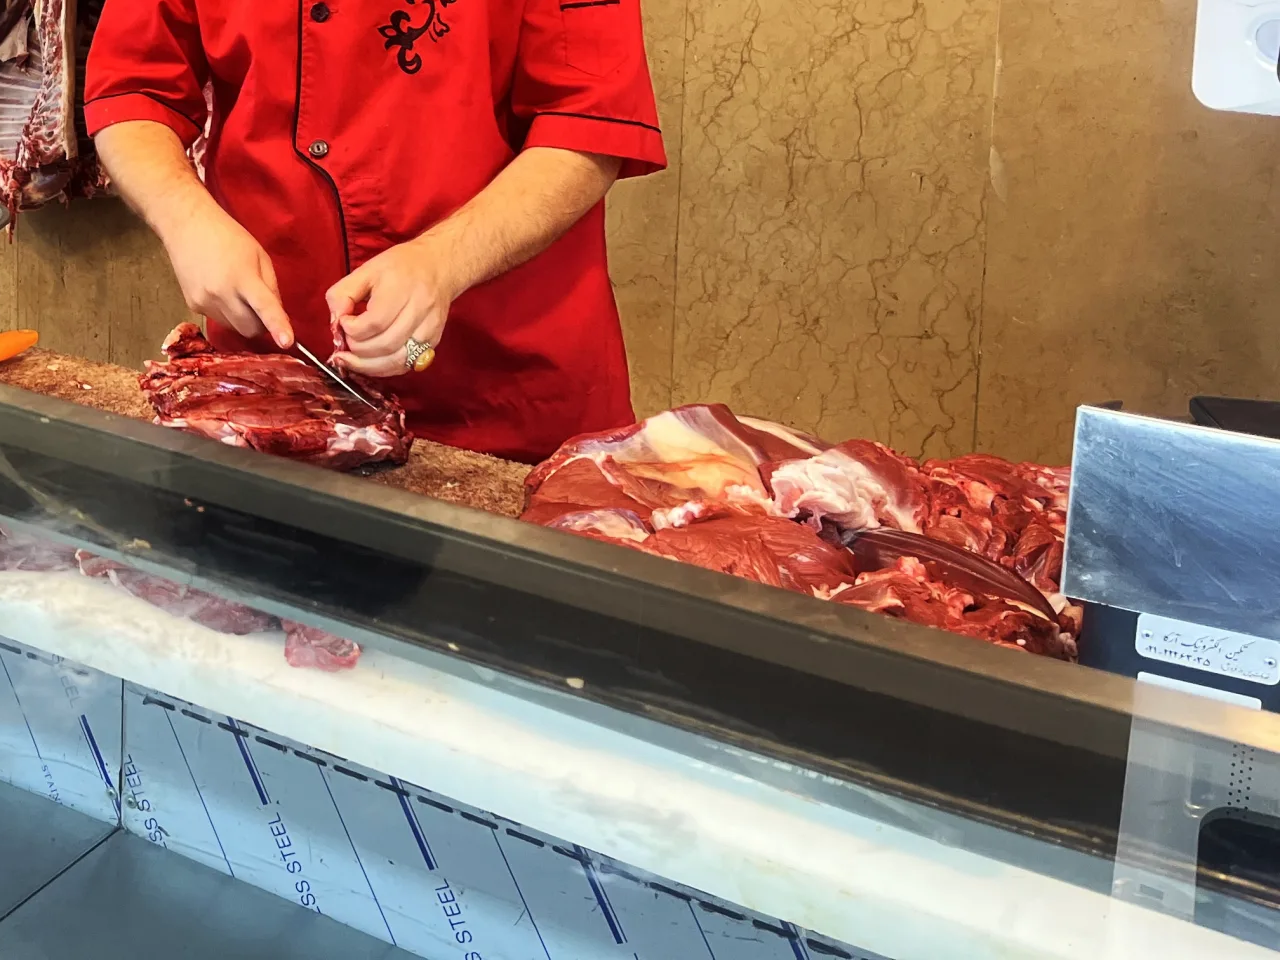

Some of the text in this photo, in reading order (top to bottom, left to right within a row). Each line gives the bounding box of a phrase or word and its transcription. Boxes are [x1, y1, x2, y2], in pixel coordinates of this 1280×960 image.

[123, 753, 151, 812] STEEL
[268, 811, 302, 874] STEEL
[435, 877, 473, 944] STEEL
